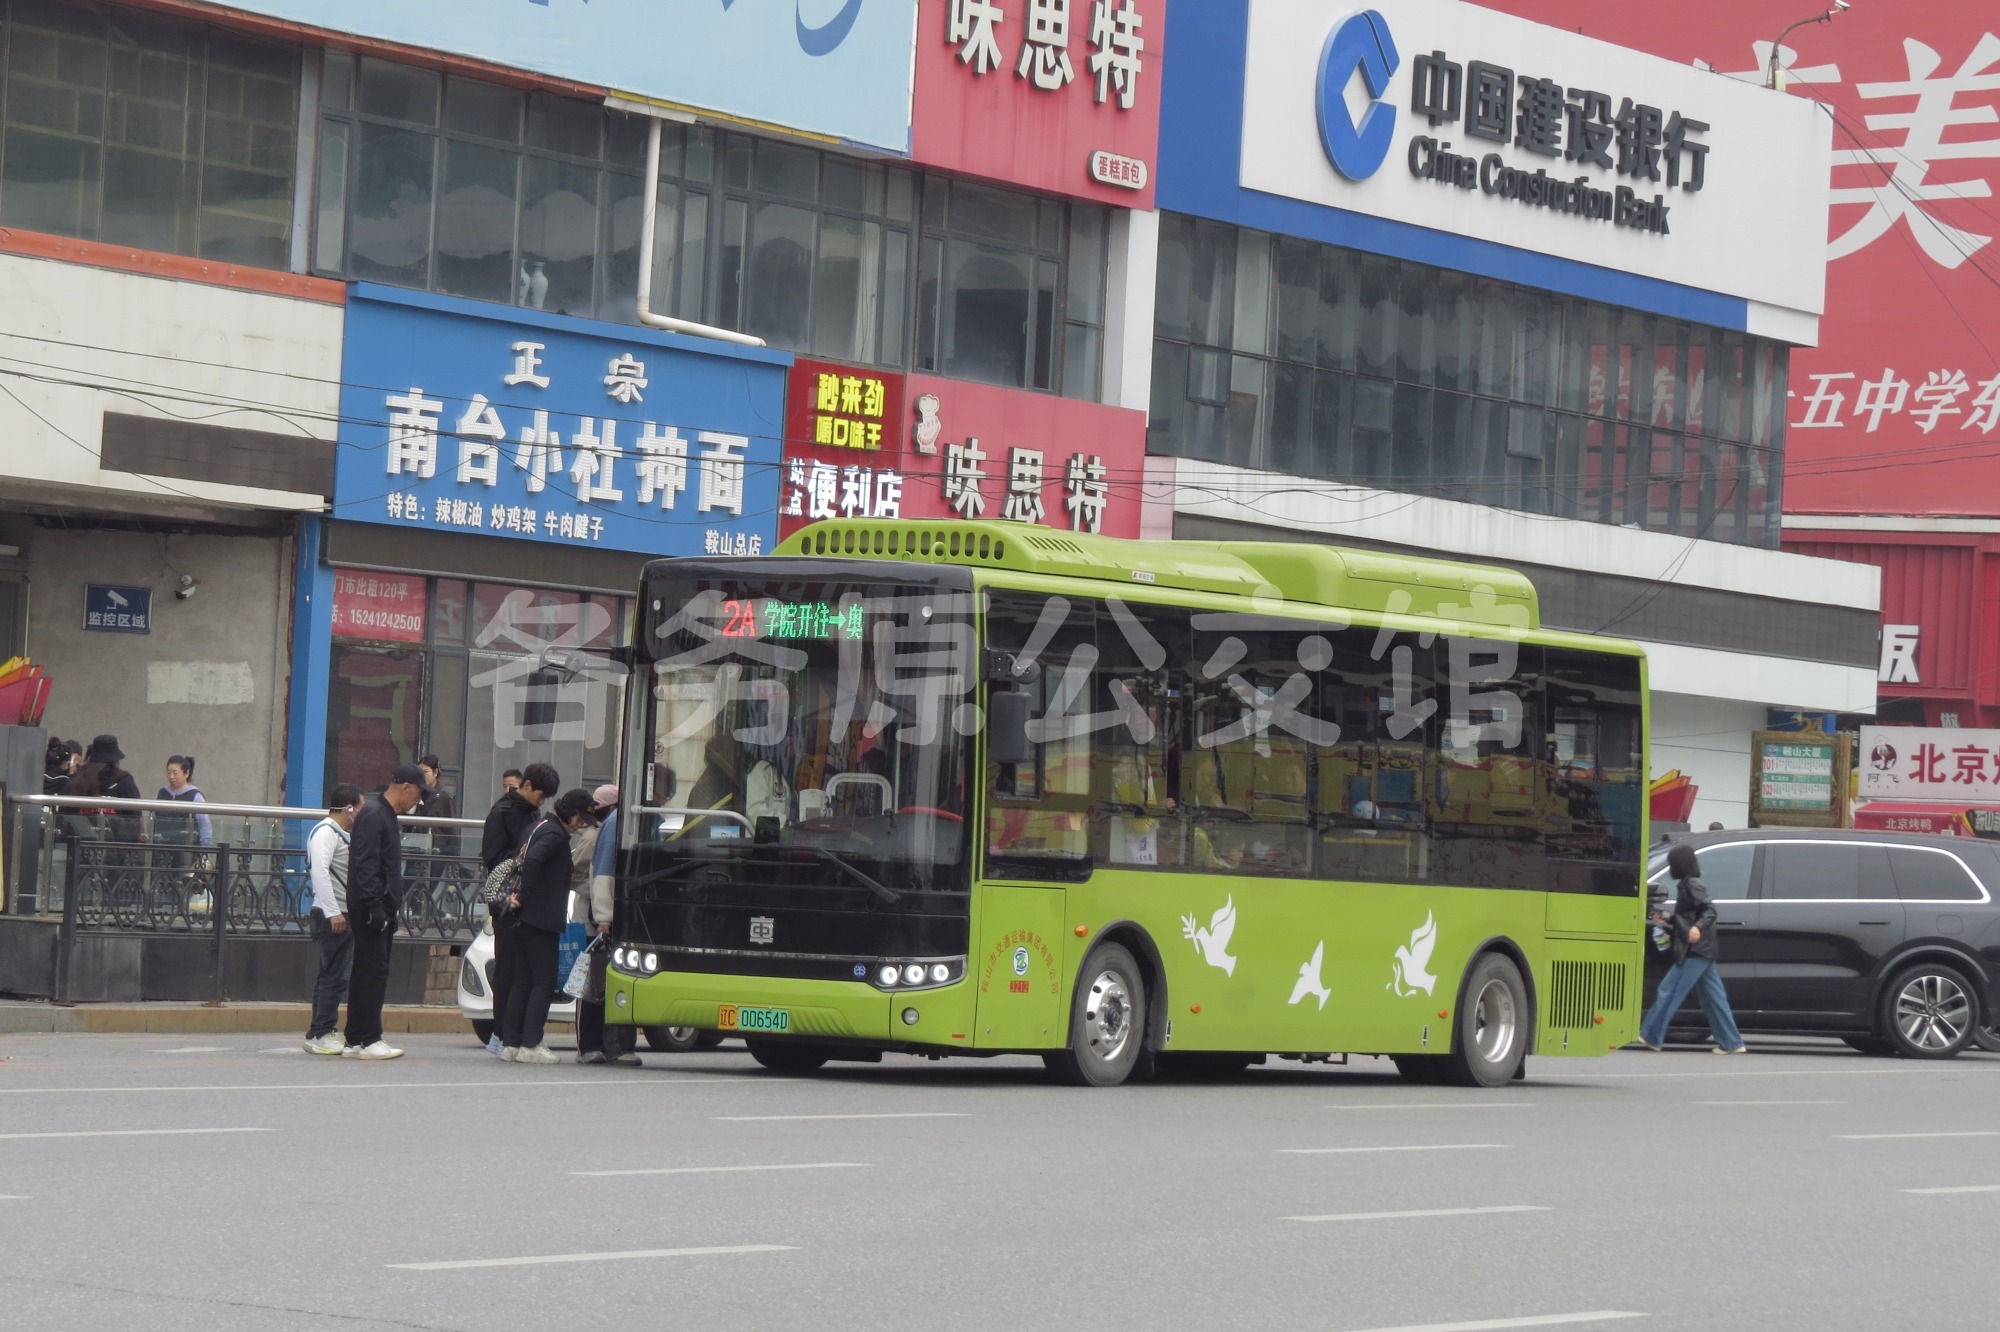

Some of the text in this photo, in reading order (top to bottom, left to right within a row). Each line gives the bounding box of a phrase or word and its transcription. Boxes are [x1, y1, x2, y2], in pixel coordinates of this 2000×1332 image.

[945, 0, 1145, 109] 味思特
[1411, 50, 1710, 192] 中国建设银行
[1098, 155, 1140, 185] 蛋糕面包
[1408, 135, 1671, 235] China Construction Bank
[504, 341, 649, 403] 正宗
[817, 373, 885, 418] 秒来劲
[1786, 366, 2000, 435] 五中学东
[386, 387, 750, 516] 南台小杜抻面
[816, 415, 882, 450] 嚼口味王
[807, 459, 903, 519] 便利店
[944, 437, 1109, 535] 味思特
[435, 497, 483, 528] 辣椒油
[490, 503, 537, 534] 炒鸡架
[544, 510, 605, 542] 牛肉腱子
[704, 529, 762, 557] 鞍山总店
[88, 611, 146, 629] 监控区域
[350, 608, 421, 631] 15241242500
[722, 600, 756, 638] 2A
[1782, 746, 1822, 758] 鞍山大厦
